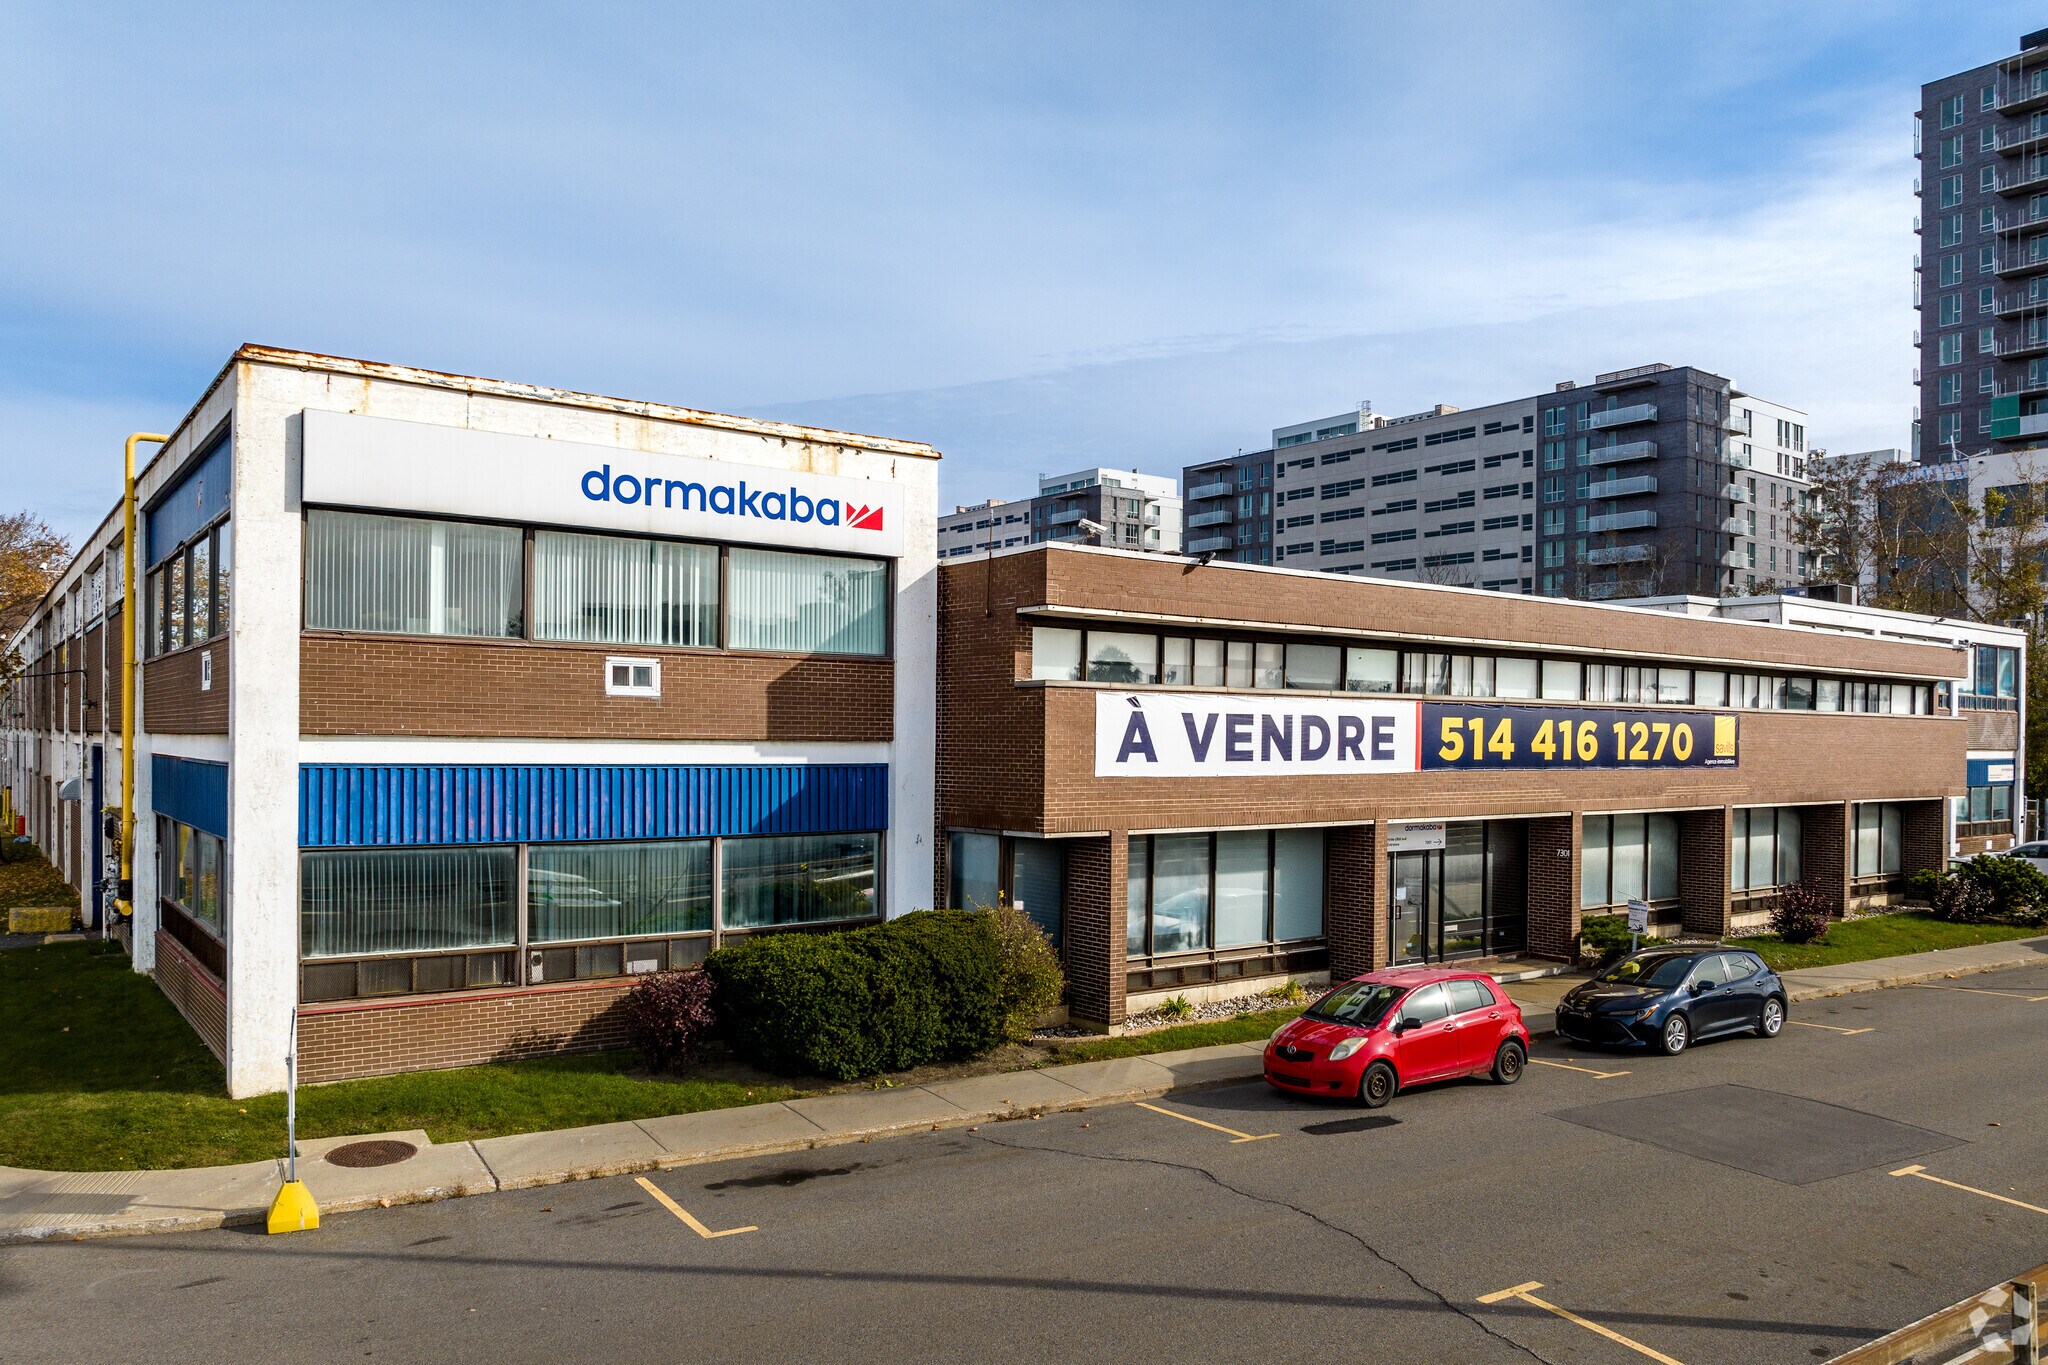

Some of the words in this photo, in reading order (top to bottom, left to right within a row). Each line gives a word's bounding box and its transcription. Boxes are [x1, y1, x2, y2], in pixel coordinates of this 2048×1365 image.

[581, 464, 839, 526] dormakaba
[1116, 695, 1158, 763] À
[1181, 712, 1395, 763] VENDRE
[1438, 716, 1515, 761] 514
[1531, 719, 1598, 761] 416
[1613, 721, 1694, 761] 1270
[1556, 848, 1570, 857] 7301
